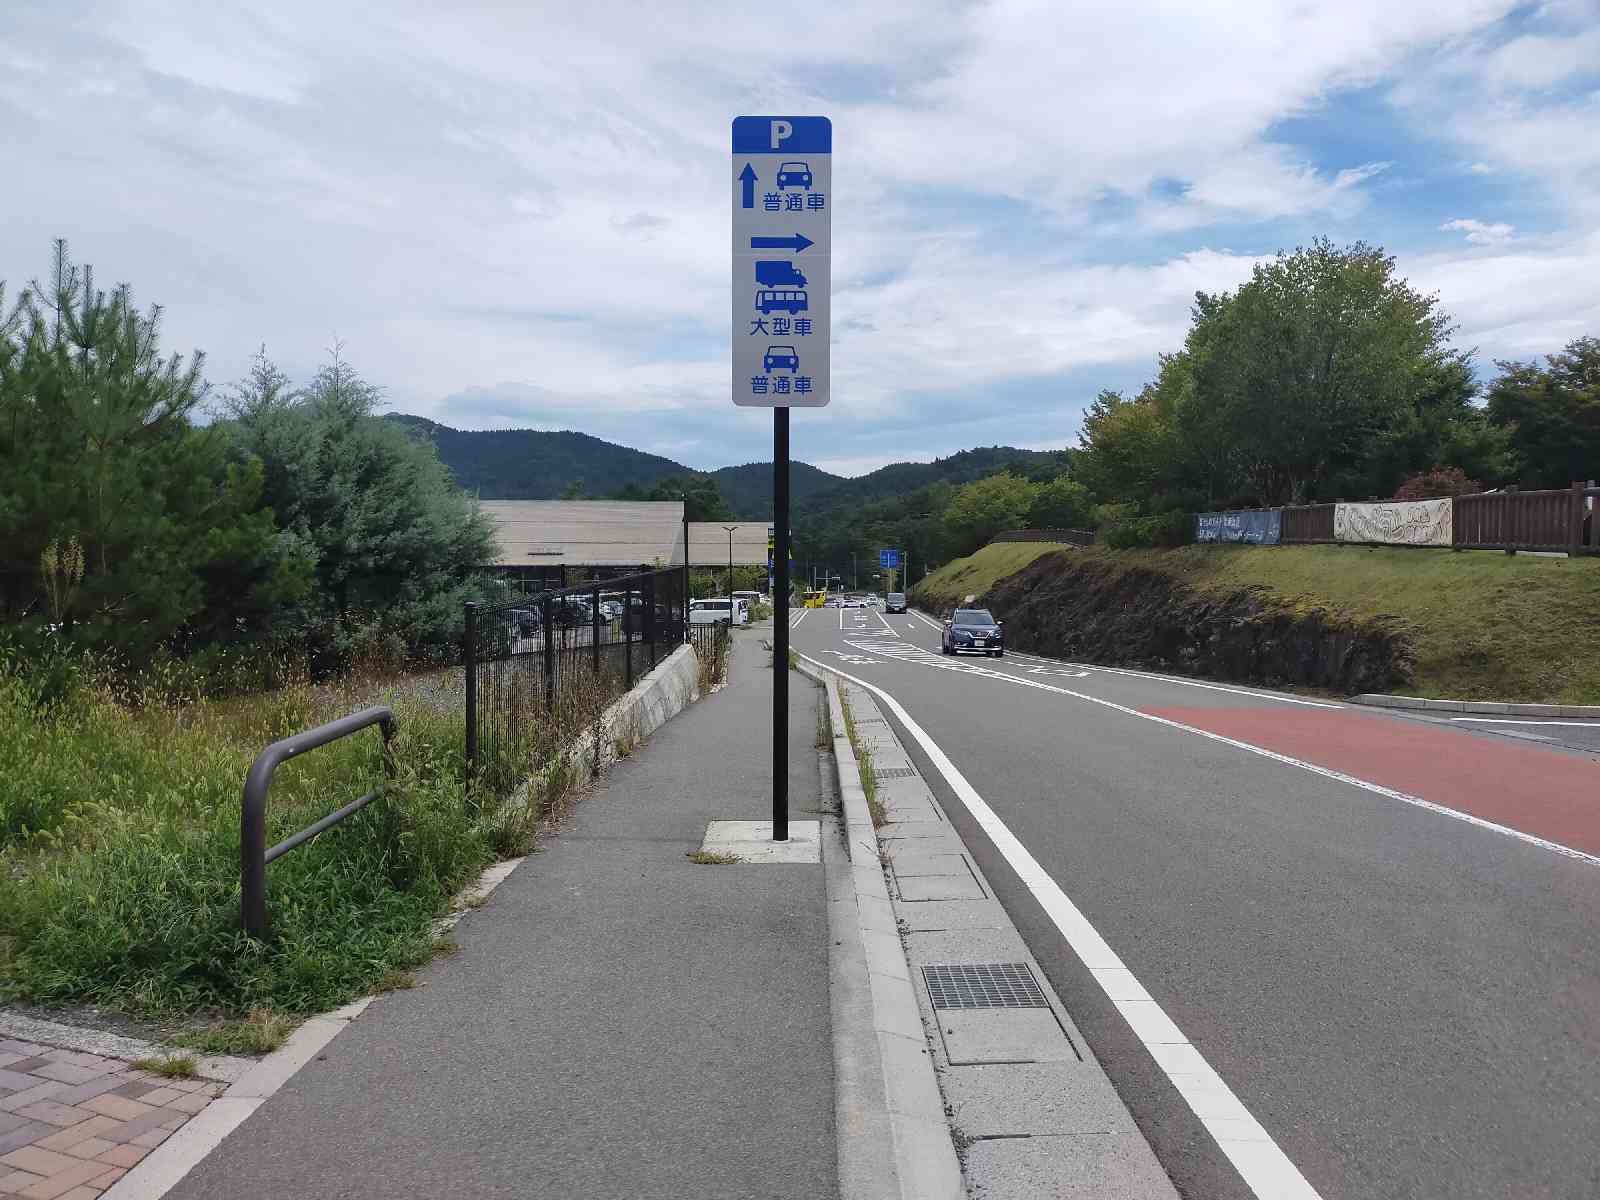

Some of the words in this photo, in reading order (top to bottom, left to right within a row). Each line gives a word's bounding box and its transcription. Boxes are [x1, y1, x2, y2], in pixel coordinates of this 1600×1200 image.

[770, 120, 793, 149] P
[763, 191, 825, 212] 普通車
[750, 317, 813, 337] 大型車
[751, 375, 813, 395] 普通車
